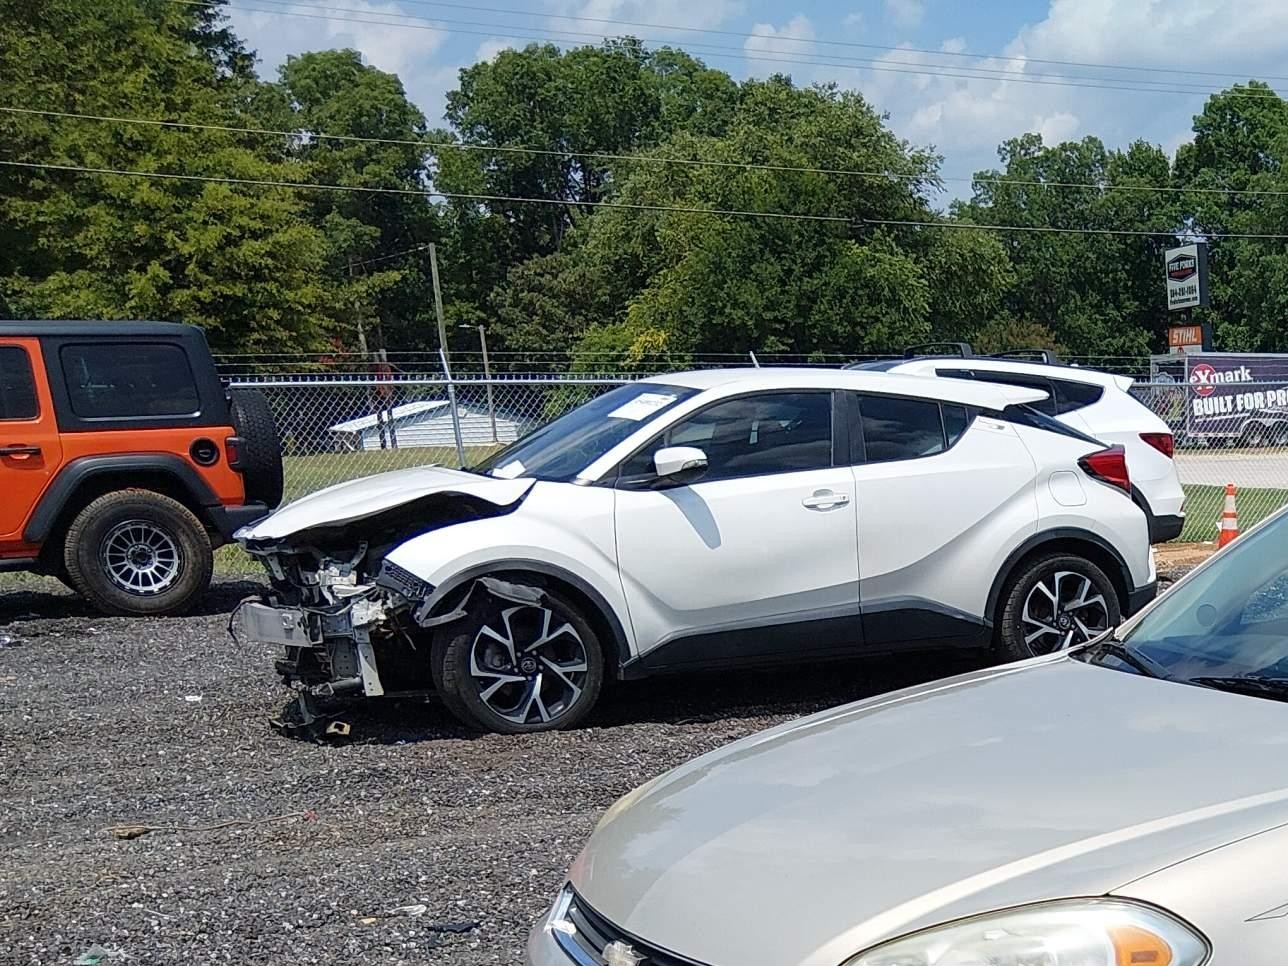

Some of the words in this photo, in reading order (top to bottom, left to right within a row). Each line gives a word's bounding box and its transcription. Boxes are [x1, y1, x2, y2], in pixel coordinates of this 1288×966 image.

[1172, 327, 1197, 343] STIHL
[1193, 395, 1233, 416] BUILT
[1236, 391, 1265, 411] FOR
